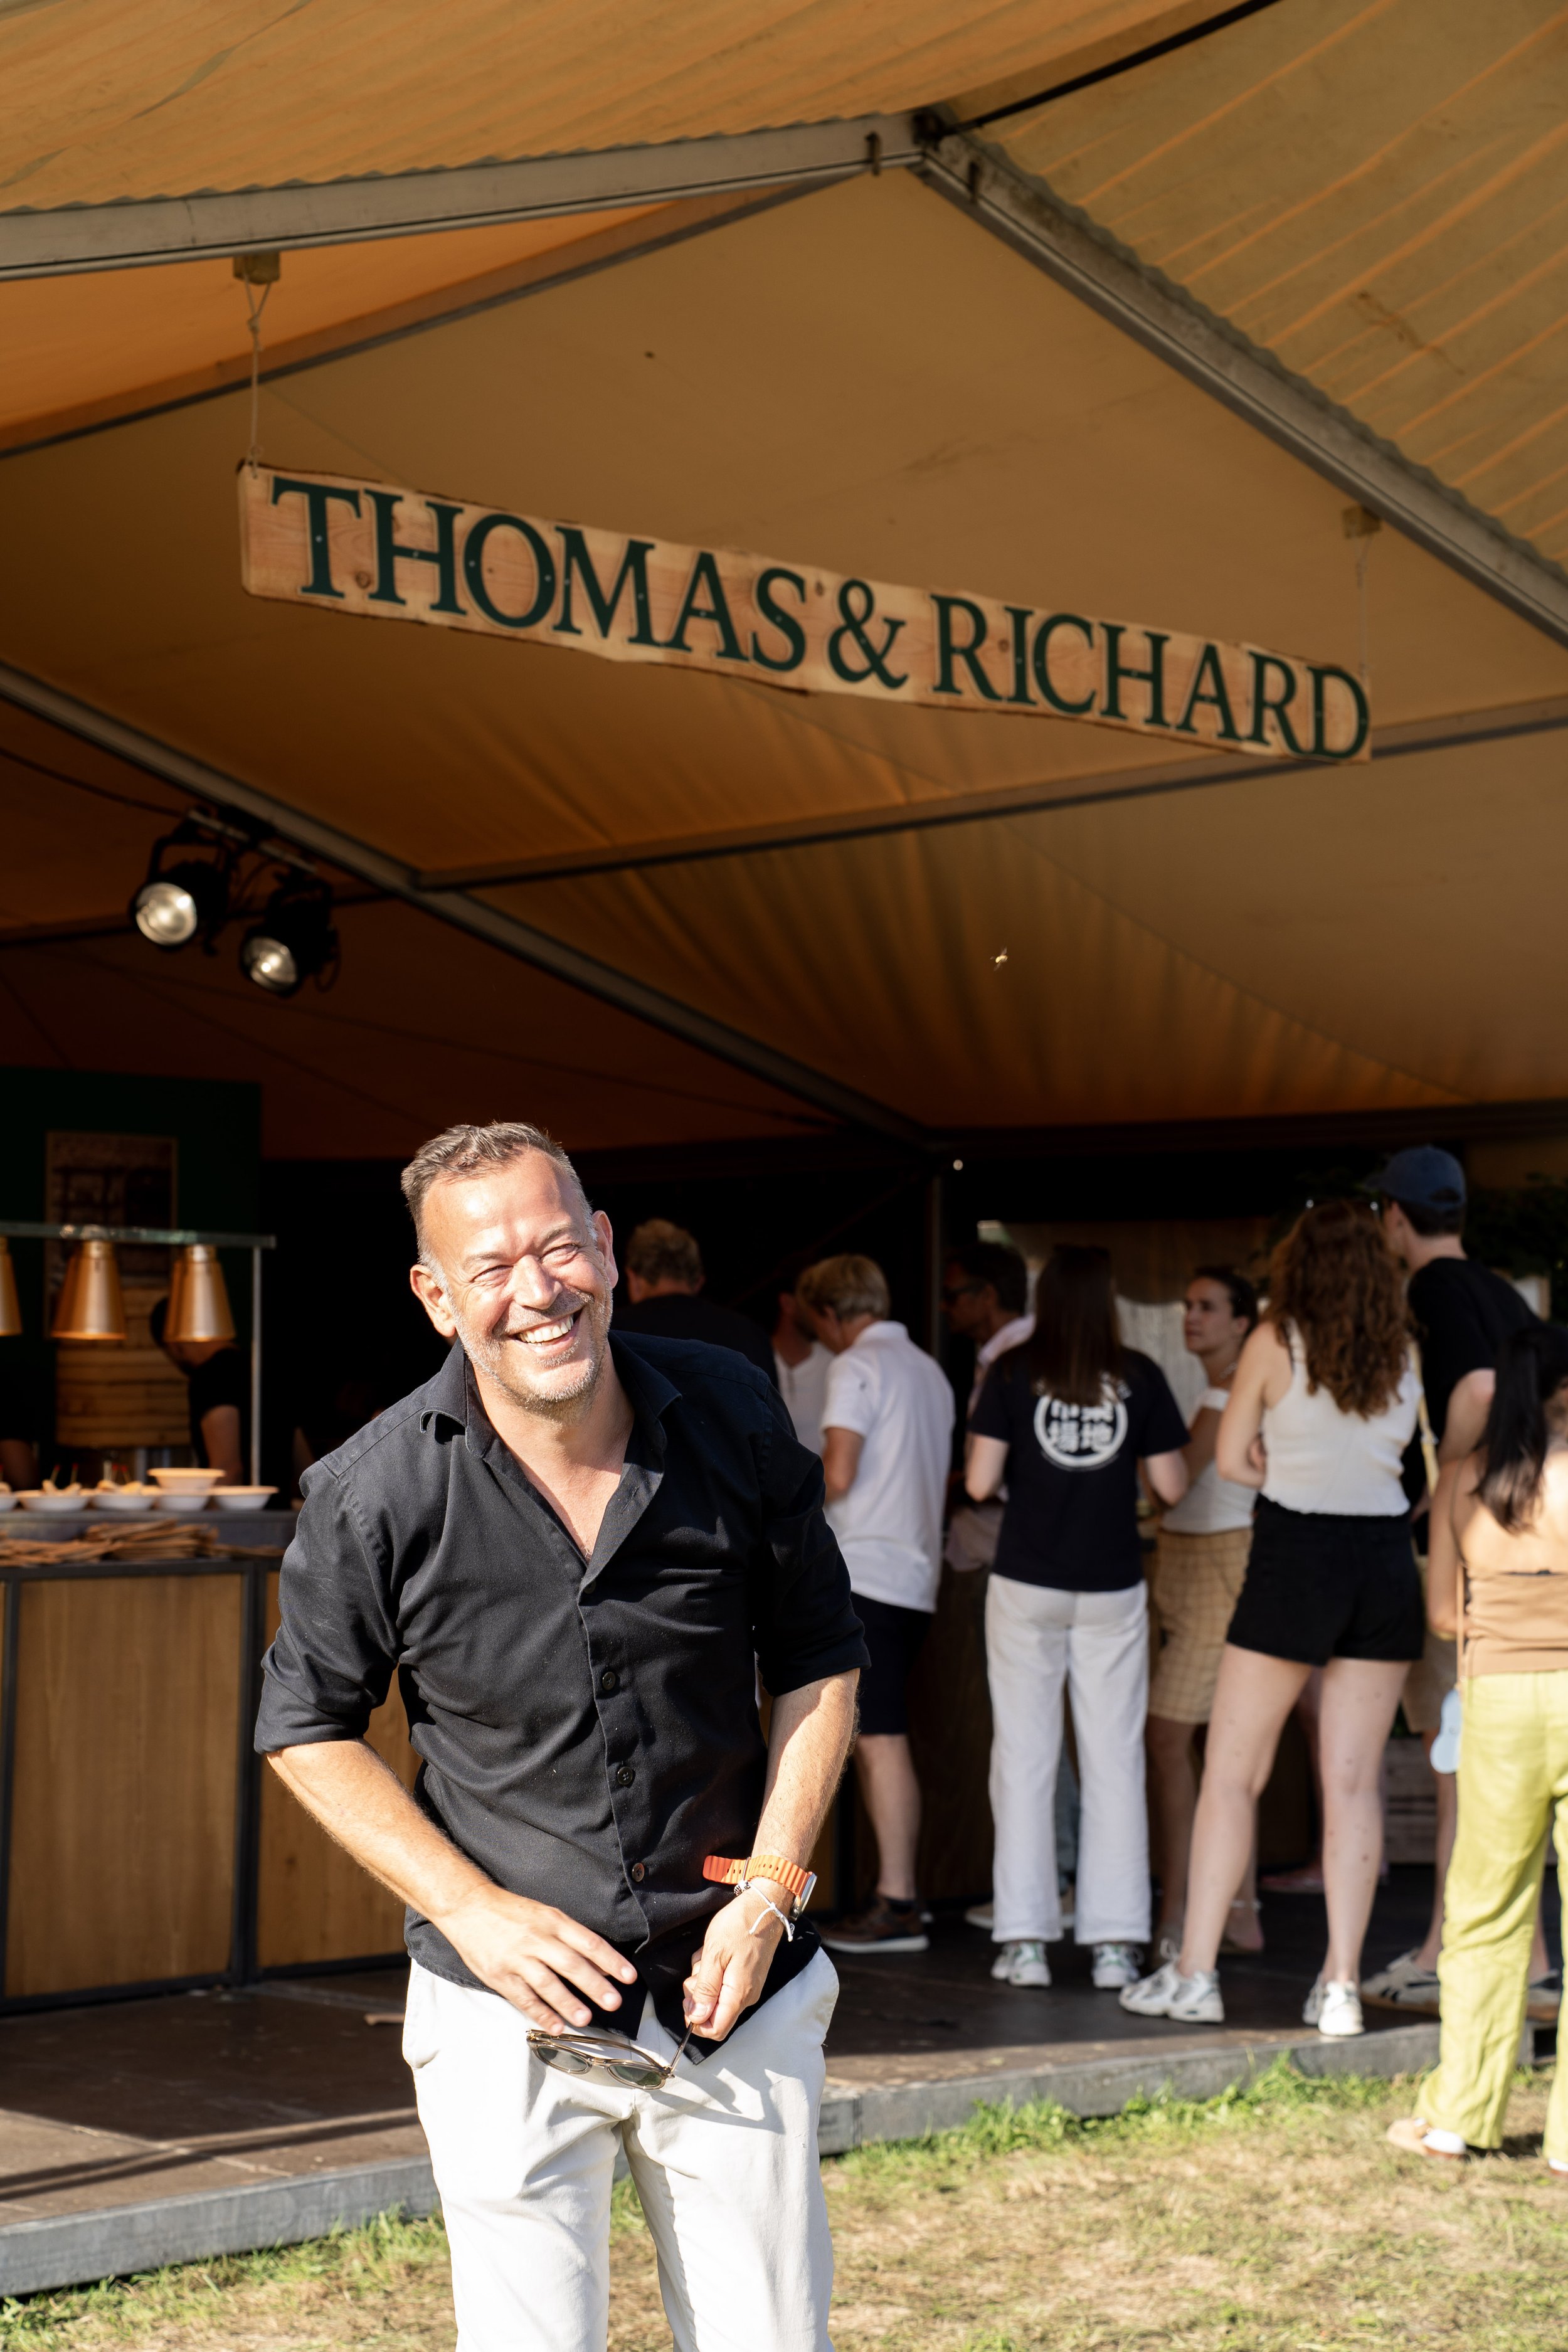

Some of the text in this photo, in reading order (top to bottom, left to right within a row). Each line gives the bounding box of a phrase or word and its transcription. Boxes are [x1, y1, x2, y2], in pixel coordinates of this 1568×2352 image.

[271, 476, 1370, 760] THOMAS & RICHARD
